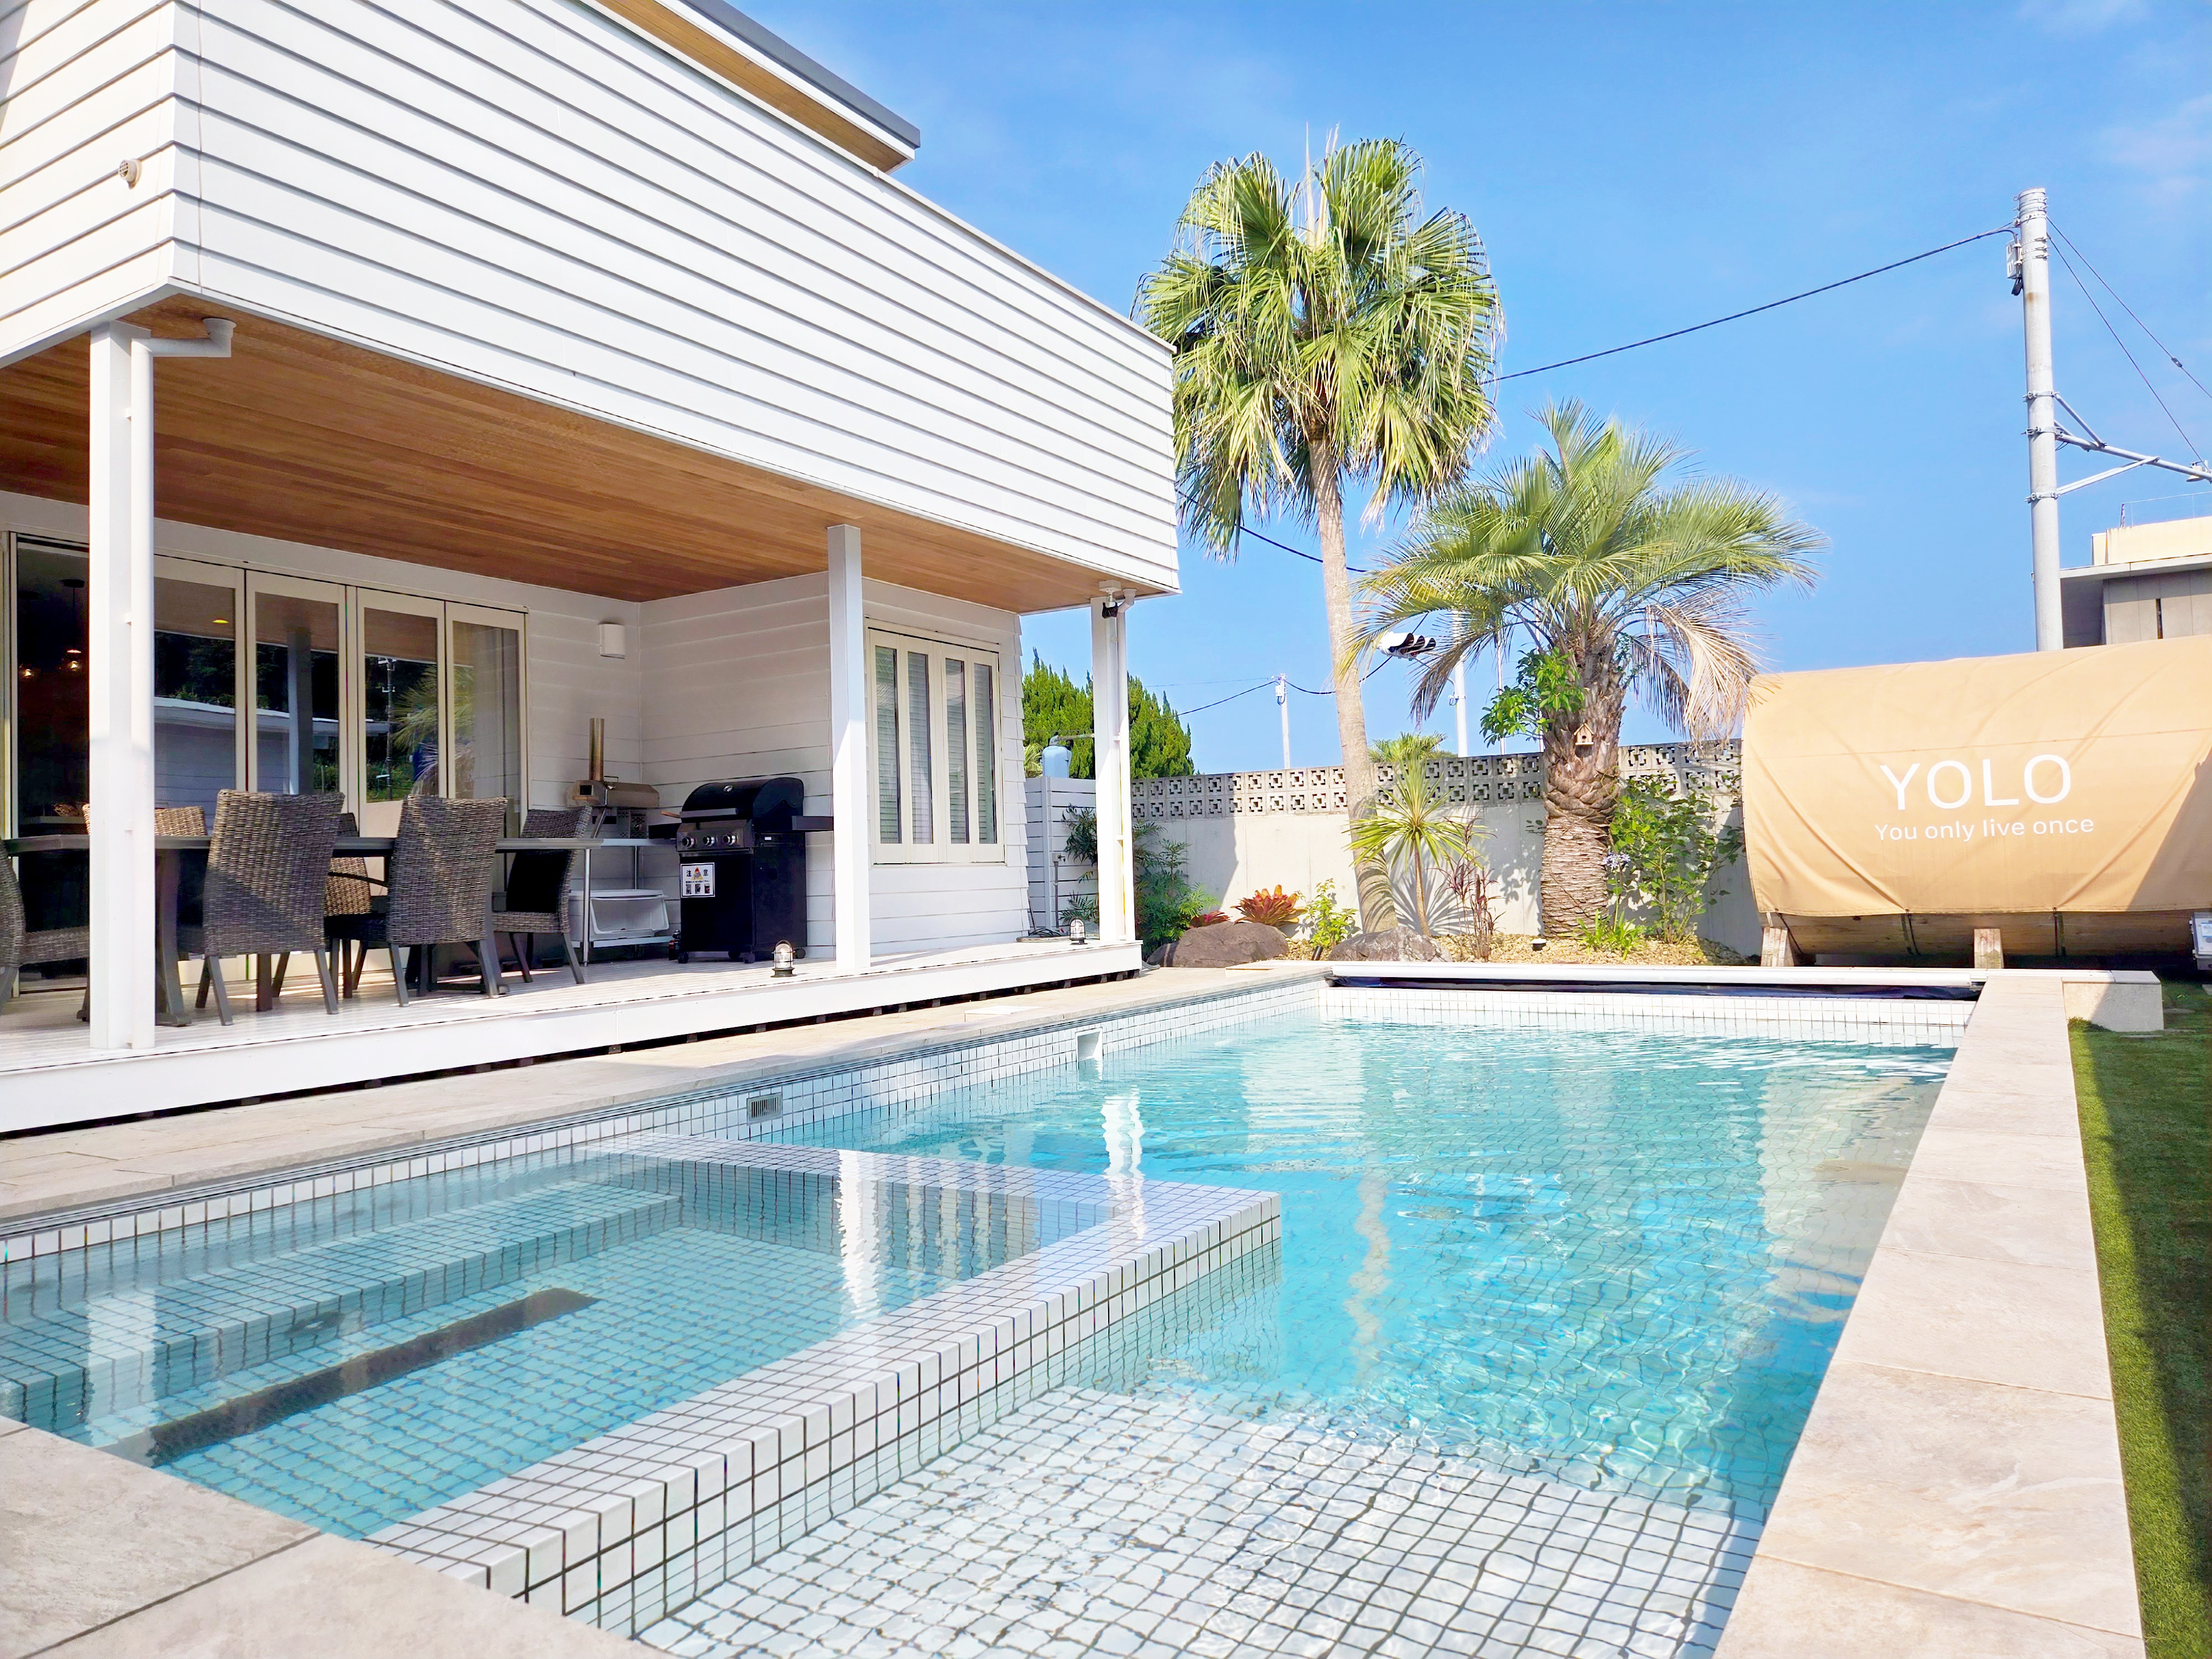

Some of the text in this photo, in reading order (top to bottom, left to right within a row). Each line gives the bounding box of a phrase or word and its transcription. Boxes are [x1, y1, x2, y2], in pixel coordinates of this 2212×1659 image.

[1879, 753, 2072, 810] YOLO
[1874, 818, 2094, 842] You only live once
